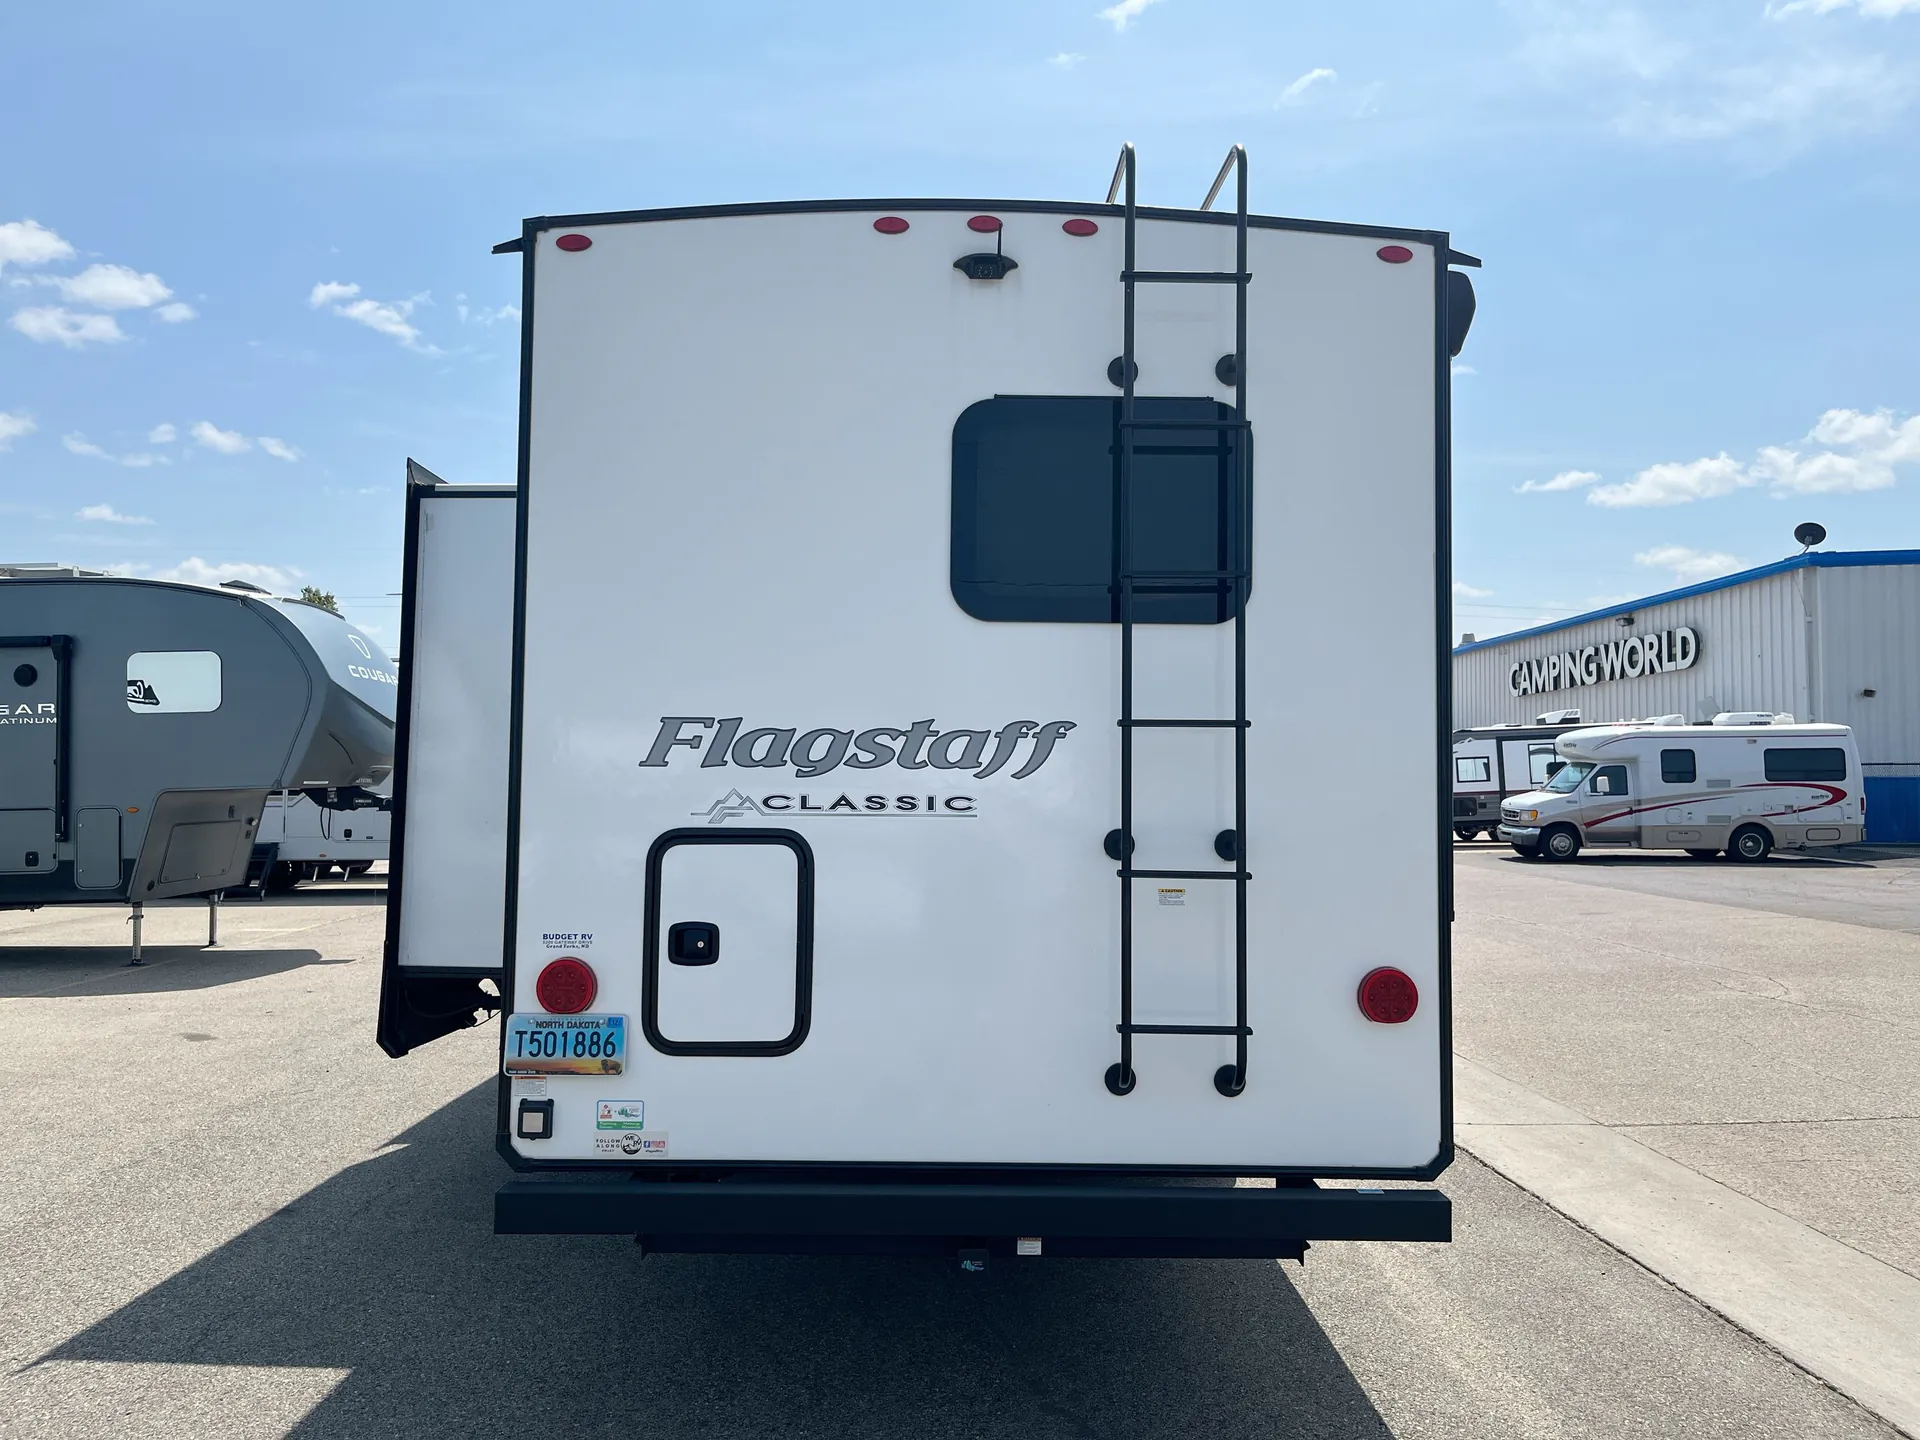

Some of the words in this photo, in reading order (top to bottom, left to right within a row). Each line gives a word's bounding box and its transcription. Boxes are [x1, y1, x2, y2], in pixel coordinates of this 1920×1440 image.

[1508, 646, 1597, 697] CAMPING
[1600, 626, 1699, 681] WORLD
[347, 664, 399, 686] COUGAR
[638, 716, 1078, 780] Flagstaff
[761, 793, 978, 813] CLASSIC
[535, 1021, 564, 1029] NORTH
[566, 1021, 601, 1029] DAKOTA
[515, 1030, 616, 1058] T501886
